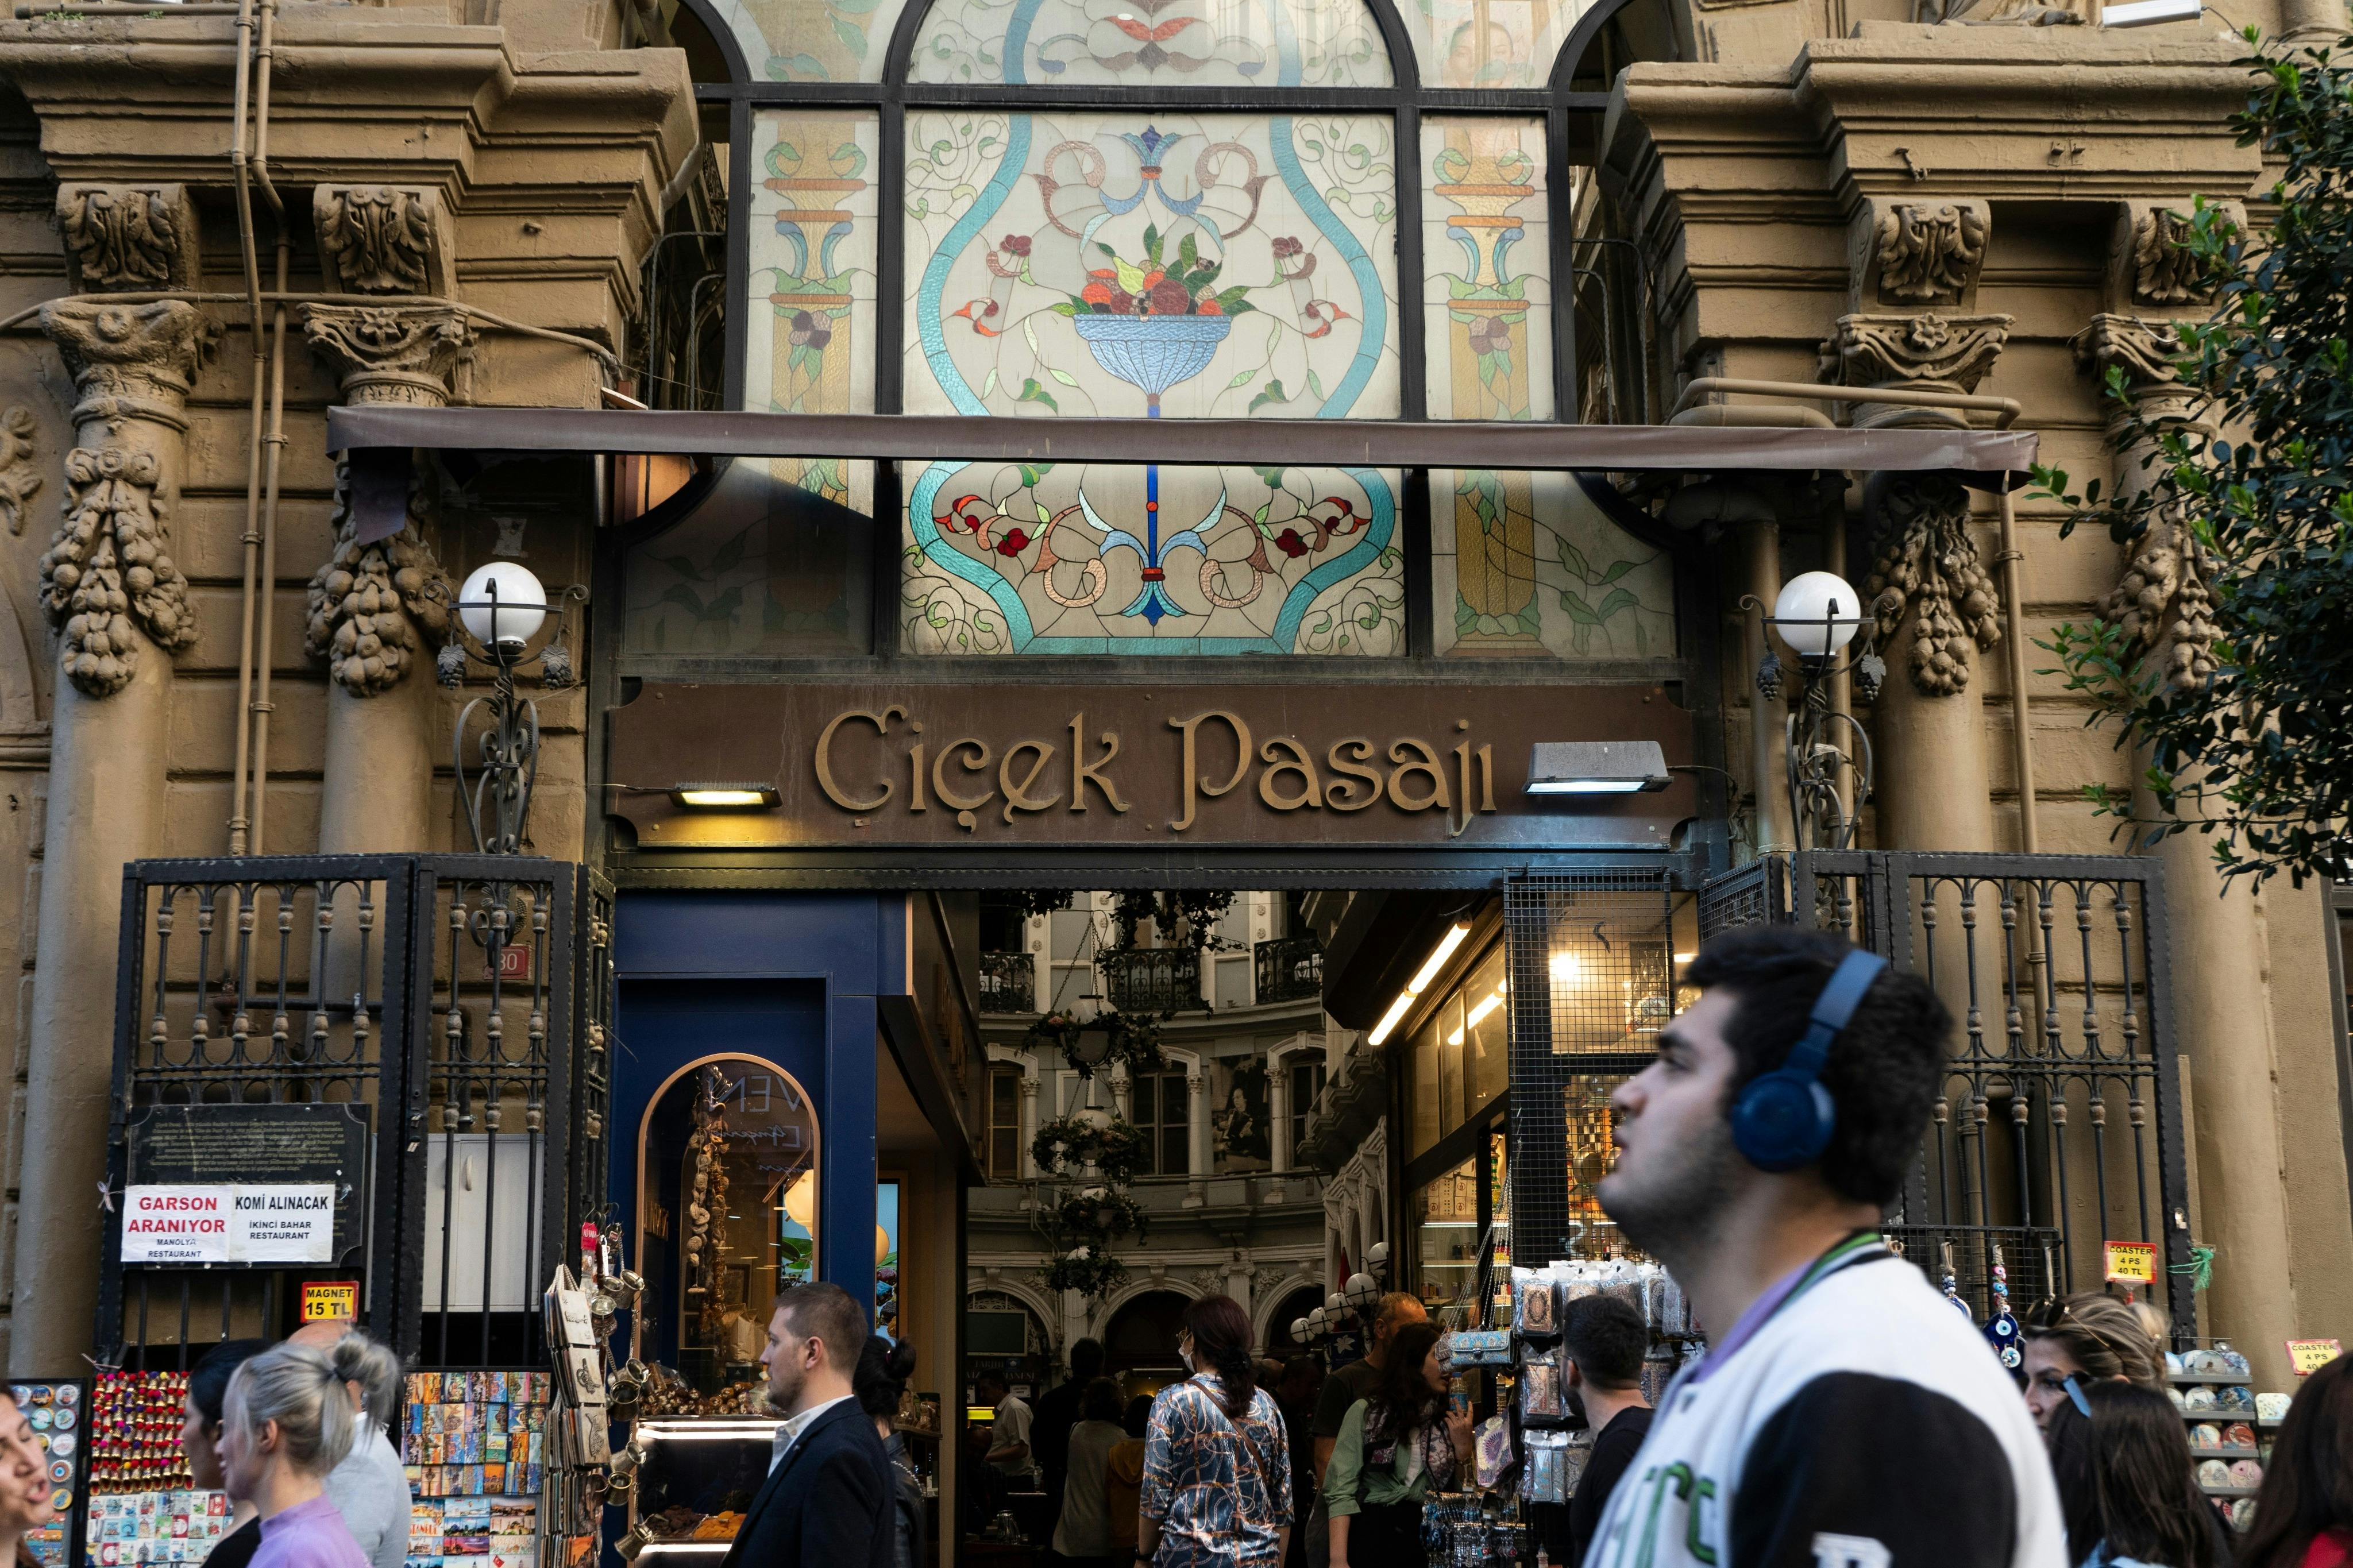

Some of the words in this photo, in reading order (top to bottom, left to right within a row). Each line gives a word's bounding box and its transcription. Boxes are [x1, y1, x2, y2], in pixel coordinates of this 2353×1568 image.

[139, 1197, 217, 1210] GARSON
[236, 1194, 265, 1210] KOMİ
[268, 1196, 329, 1210] ALINACAK
[128, 1219, 225, 1233] ARANIYOR
[249, 1220, 277, 1229] İKİNCİ
[2109, 1246, 2153, 1256] COASTER
[306, 1289, 353, 1297] MAGNET
[306, 1302, 324, 1315] 15
[330, 1303, 350, 1315] TL
